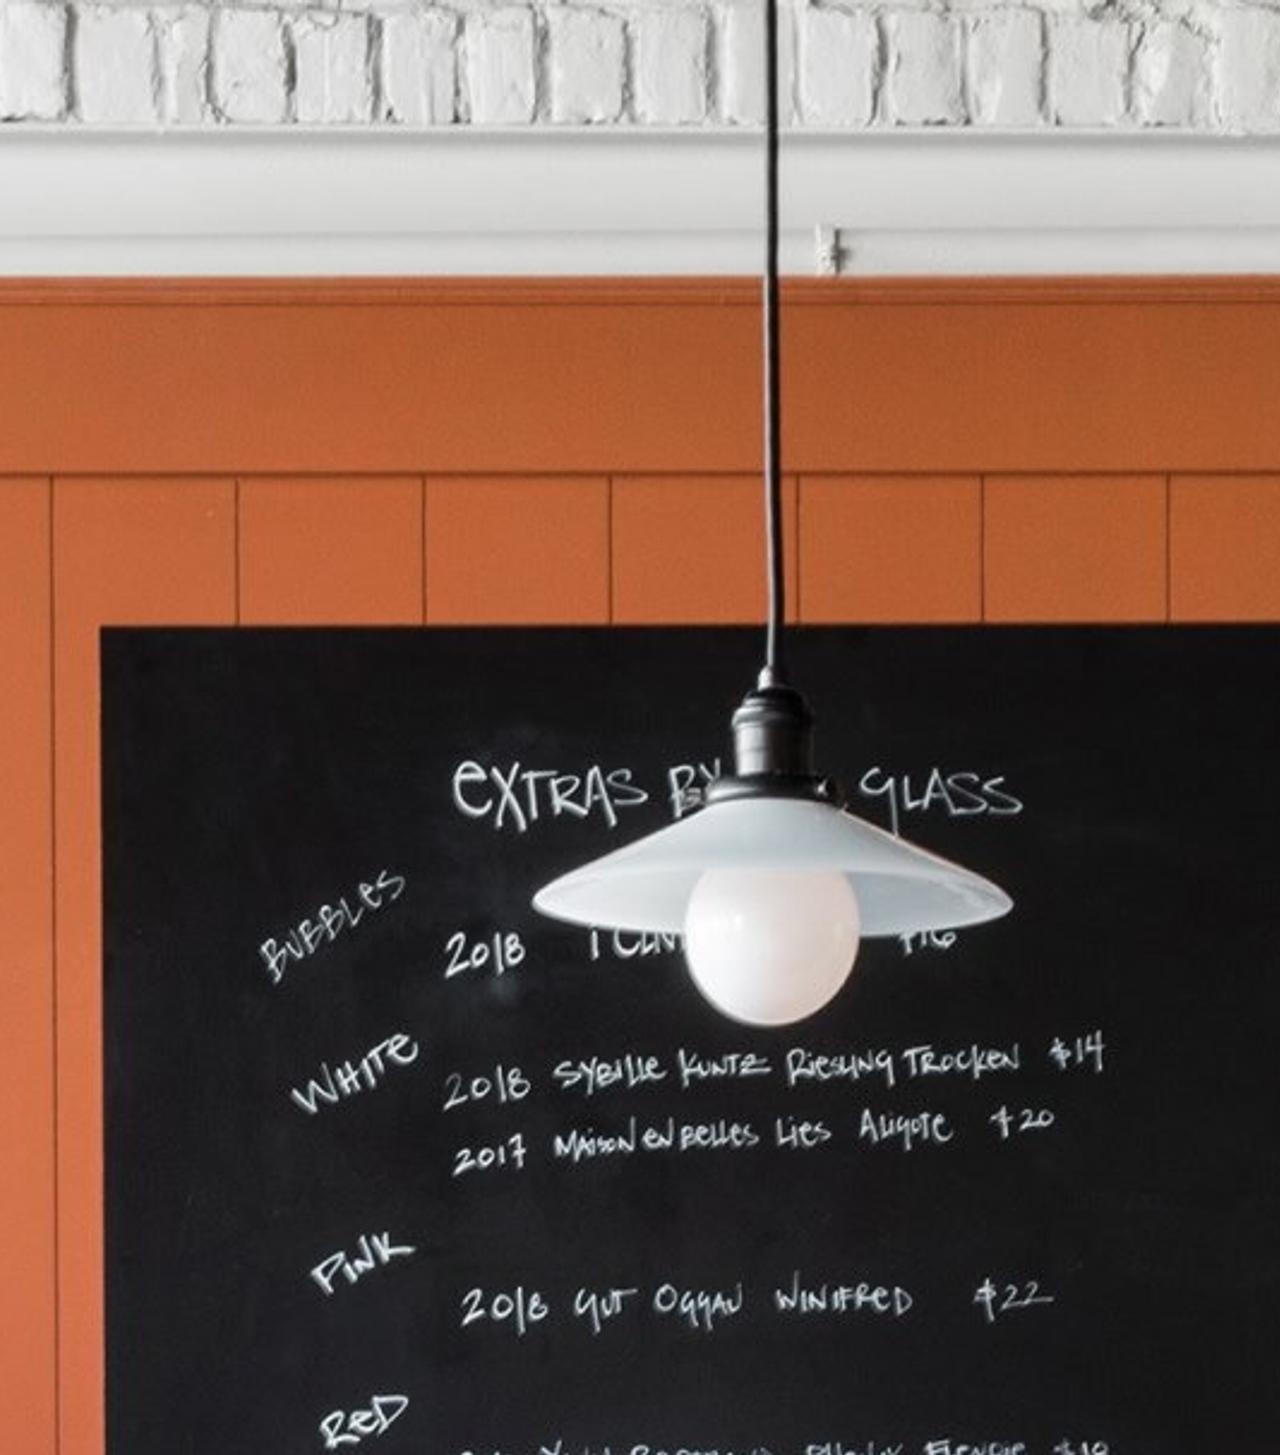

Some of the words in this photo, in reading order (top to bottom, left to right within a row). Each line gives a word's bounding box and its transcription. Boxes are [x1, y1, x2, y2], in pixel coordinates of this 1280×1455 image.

[859, 766, 1023, 837] GLASS
[444, 931, 526, 979] 2018
[443, 1064, 531, 1112] 2018
[1048, 1028, 1106, 1073] $14
[452, 1133, 527, 1178] 2017
[989, 1104, 1056, 1140] $20
[461, 1286, 550, 1335] 2018
[973, 1276, 1055, 1322] $22
